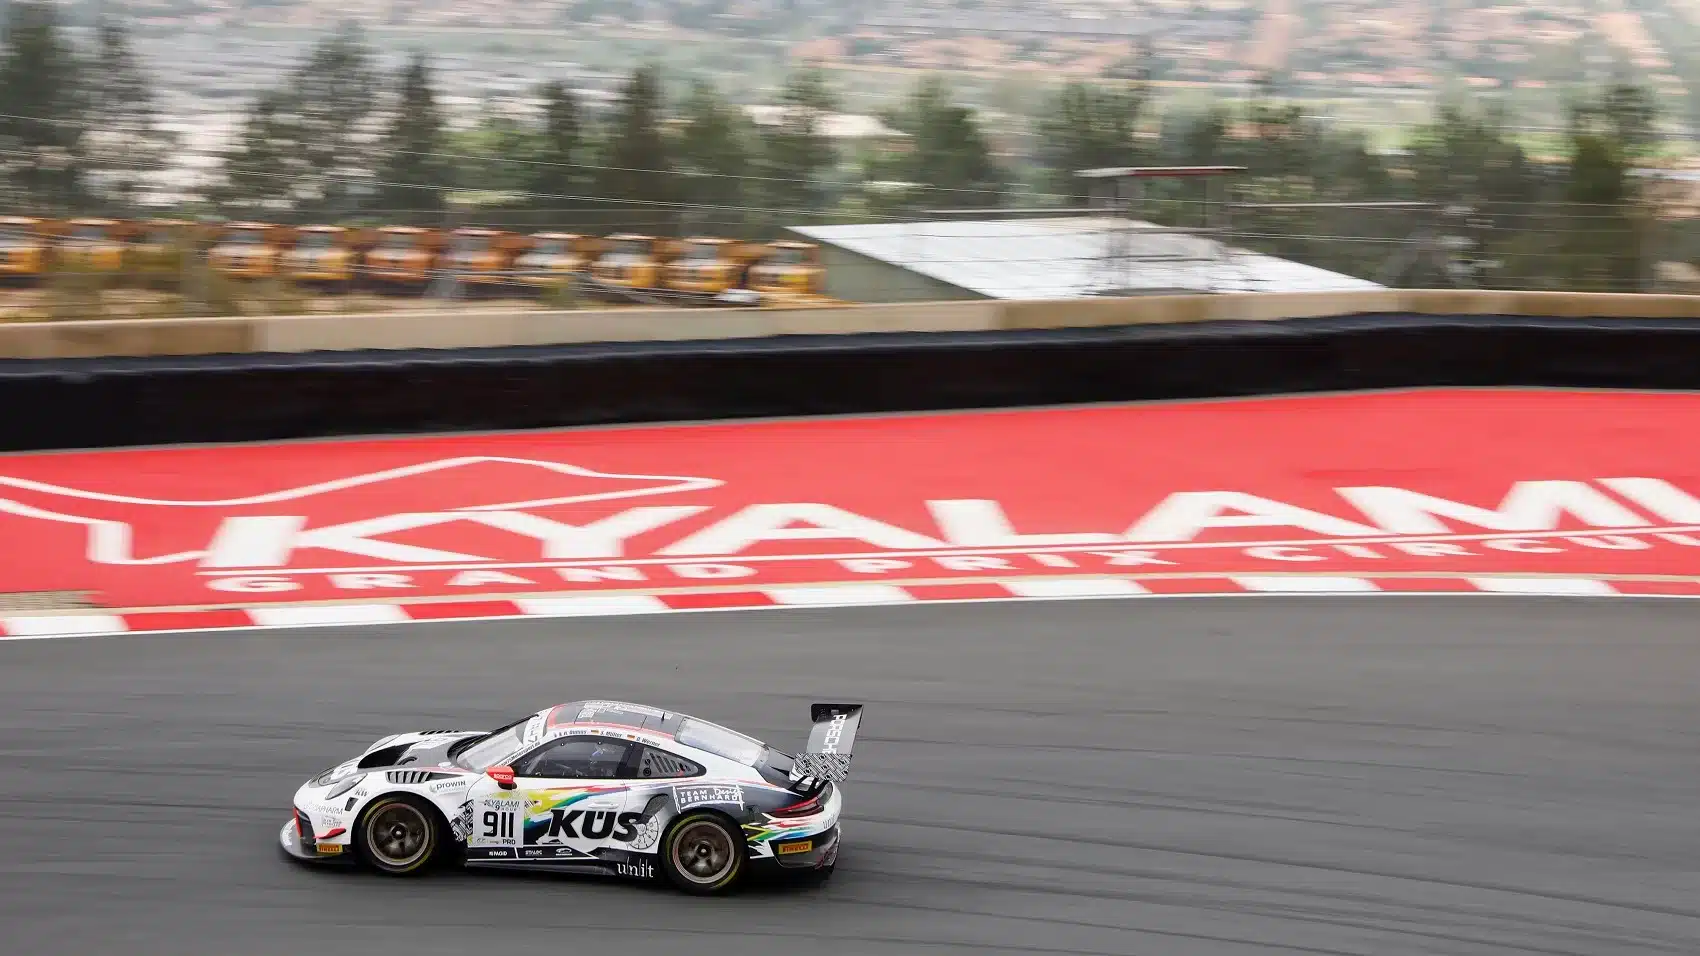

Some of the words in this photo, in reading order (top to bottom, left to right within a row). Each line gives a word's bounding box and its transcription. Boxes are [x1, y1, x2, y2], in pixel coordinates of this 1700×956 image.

[197, 477, 1700, 568] KYALAMI
[204, 562, 757, 592] GRAND
[834, 551, 1181, 574] PRIX
[681, 789, 707, 797] TEAM
[681, 794, 738, 803] BERNHARD
[483, 811, 514, 838] 911
[548, 809, 641, 842] KÜS
